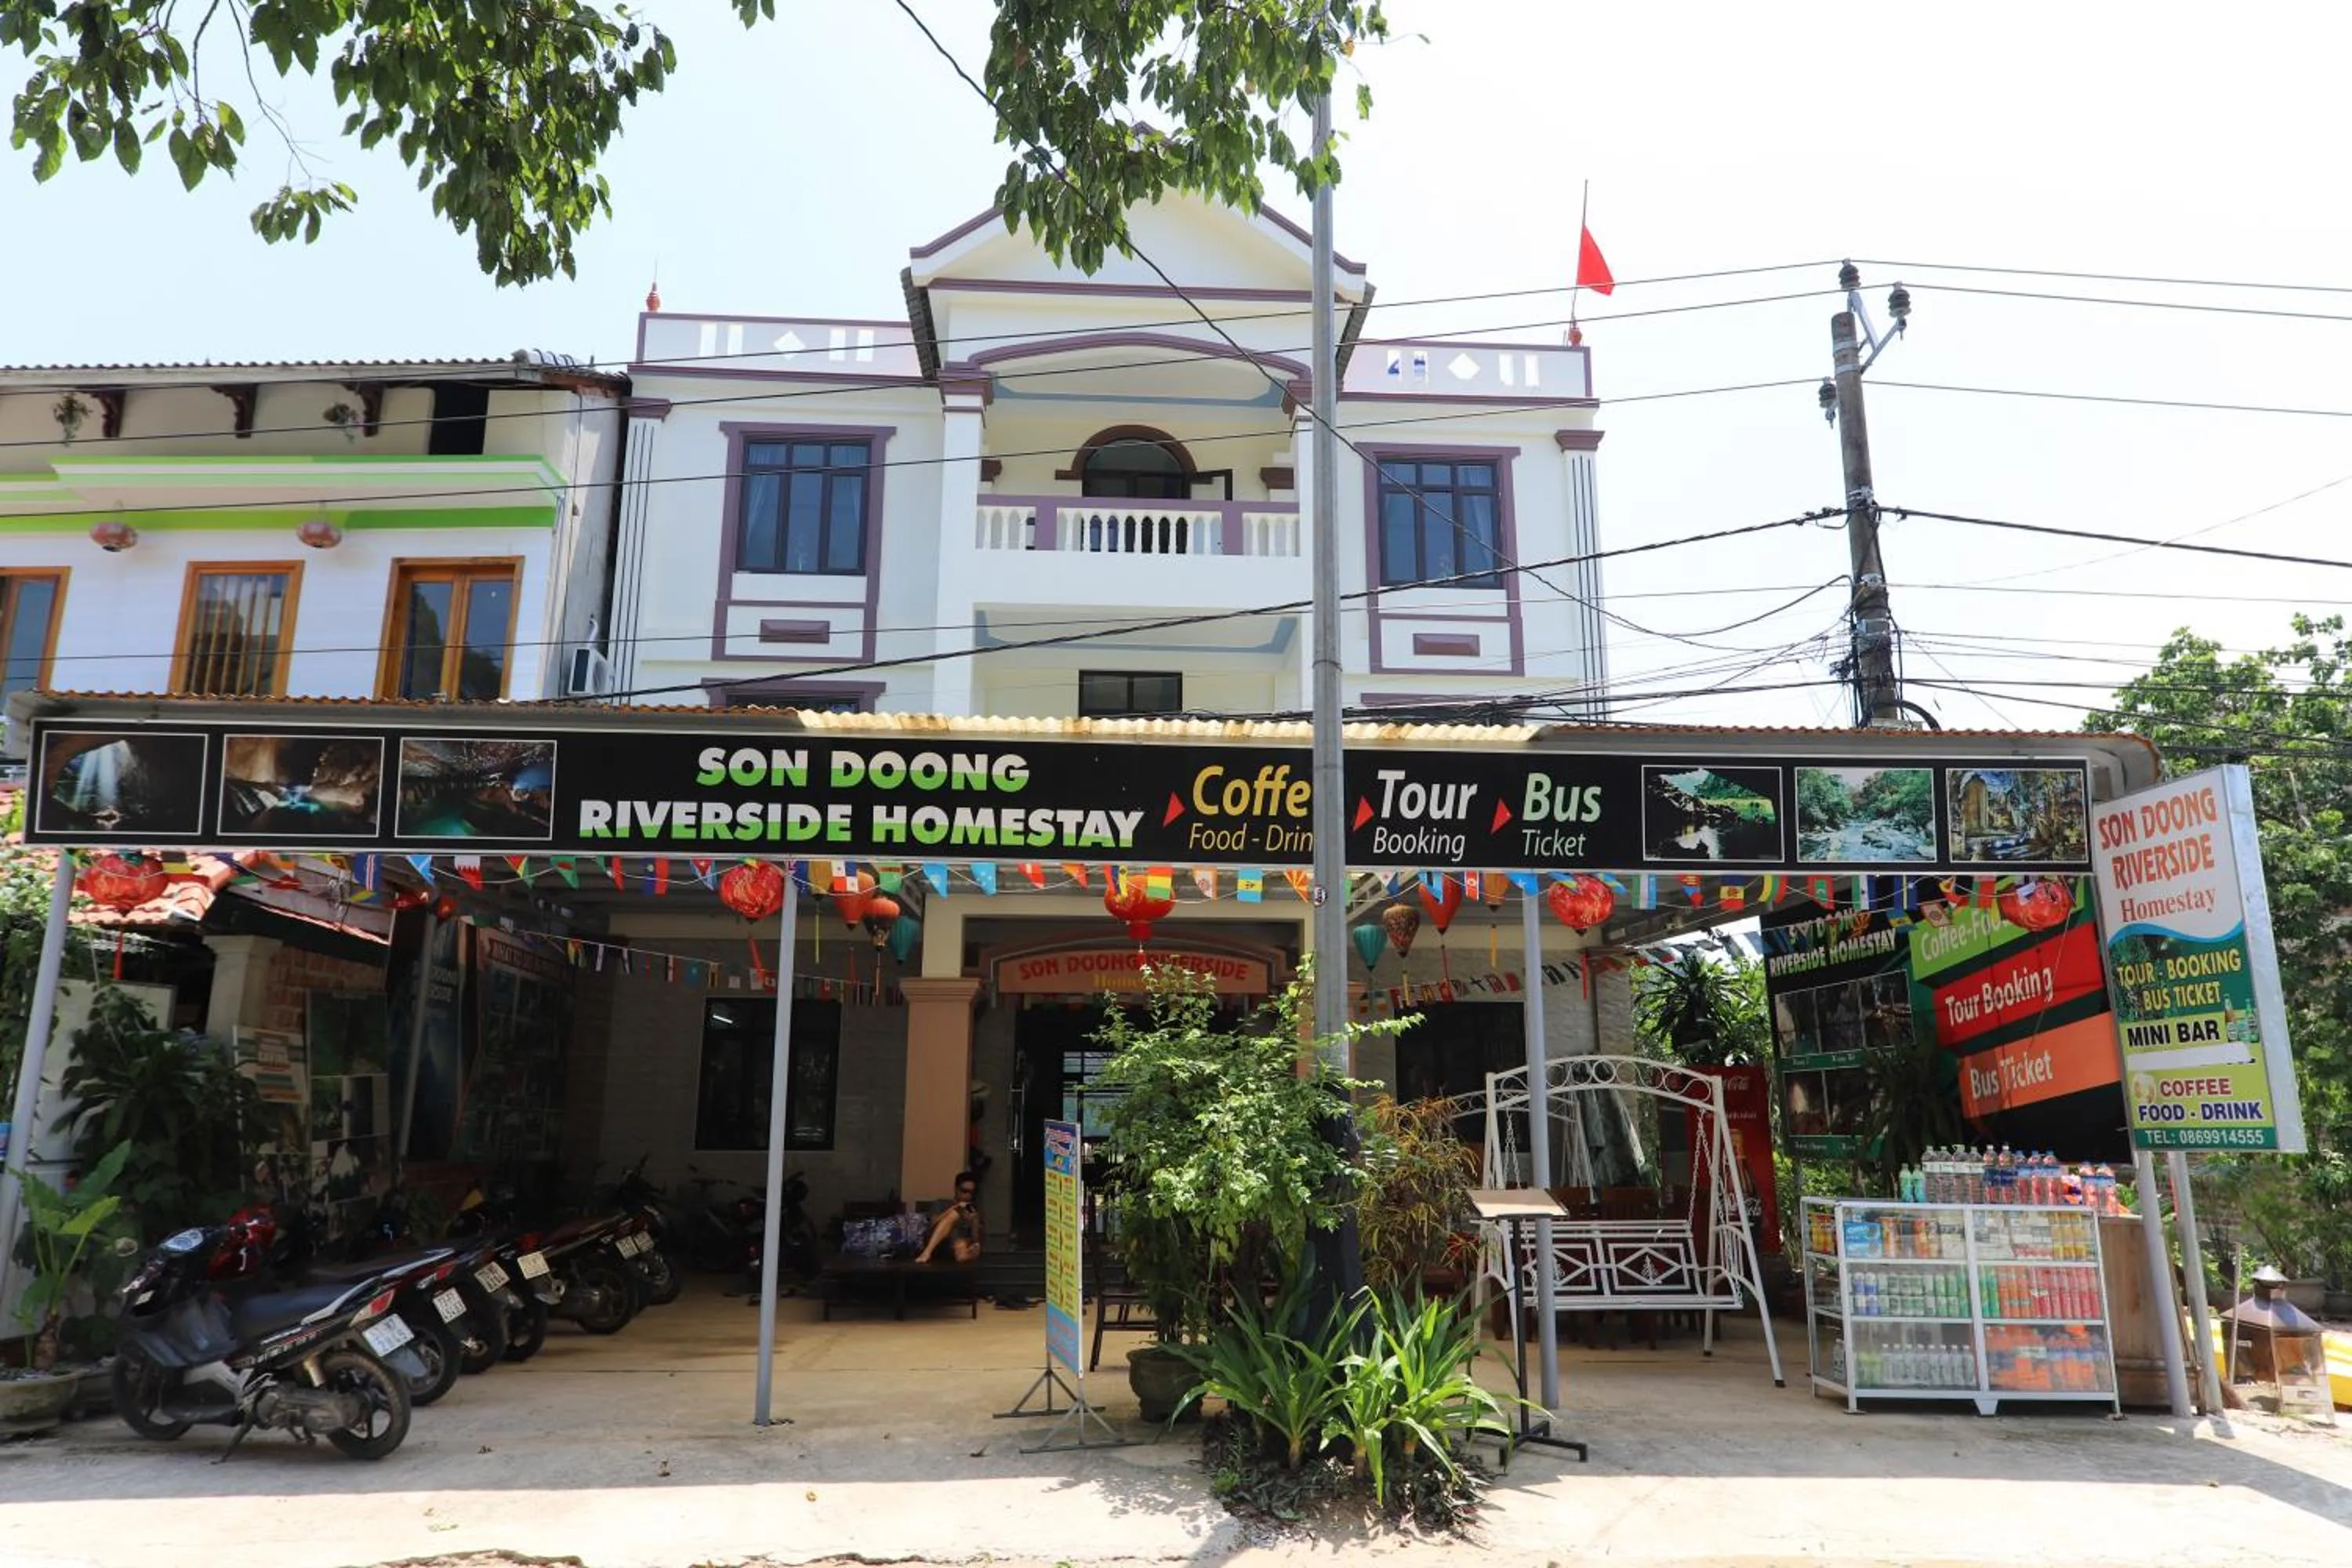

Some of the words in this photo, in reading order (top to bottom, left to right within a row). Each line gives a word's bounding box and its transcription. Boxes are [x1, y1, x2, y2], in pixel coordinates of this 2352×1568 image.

[697, 747, 808, 786] SON
[830, 750, 1029, 792] DOONG
[1192, 764, 1312, 818] Coffe
[1377, 769, 1477, 820] Tour
[1522, 771, 1602, 824] Bus
[579, 800, 852, 841] RIVERSIDE
[872, 805, 1145, 848] HOMESTAY
[1189, 822, 1245, 851] Food
[1265, 824, 1314, 852] Drin
[2098, 810, 2138, 851] SON
[2140, 787, 2217, 839] DOONG
[1373, 826, 1466, 862] Booking
[1521, 828, 1587, 858] Ticket
[2111, 833, 2215, 891] RIVERSIDE
[2120, 888, 2216, 923] Homestay
[1018, 957, 1059, 980] SON
[1068, 953, 1140, 973] DOONG
[1769, 946, 1826, 978] RIVERSIDE
[1829, 928, 1896, 966] HOMESTAY
[2118, 961, 2154, 987] TOUR
[2165, 948, 2241, 980] BOOKING
[1945, 993, 1981, 1026] Tour
[1982, 966, 2054, 1014] Booking
[2142, 987, 2171, 1011] BUS
[2173, 981, 2220, 1007] TICKET
[2127, 1023, 2171, 1047] MINI
[2176, 1020, 2220, 1044] BAR
[1970, 1066, 1999, 1098] Bus
[2001, 1049, 2054, 1091] Ticket
[2160, 1078, 2232, 1098] COFFEE
[2138, 1103, 2185, 1121] FOOD
[2201, 1102, 2263, 1120] DRINK
[2144, 1130, 2176, 1145] TEL:
[2179, 1130, 2264, 1145] 0869914555
